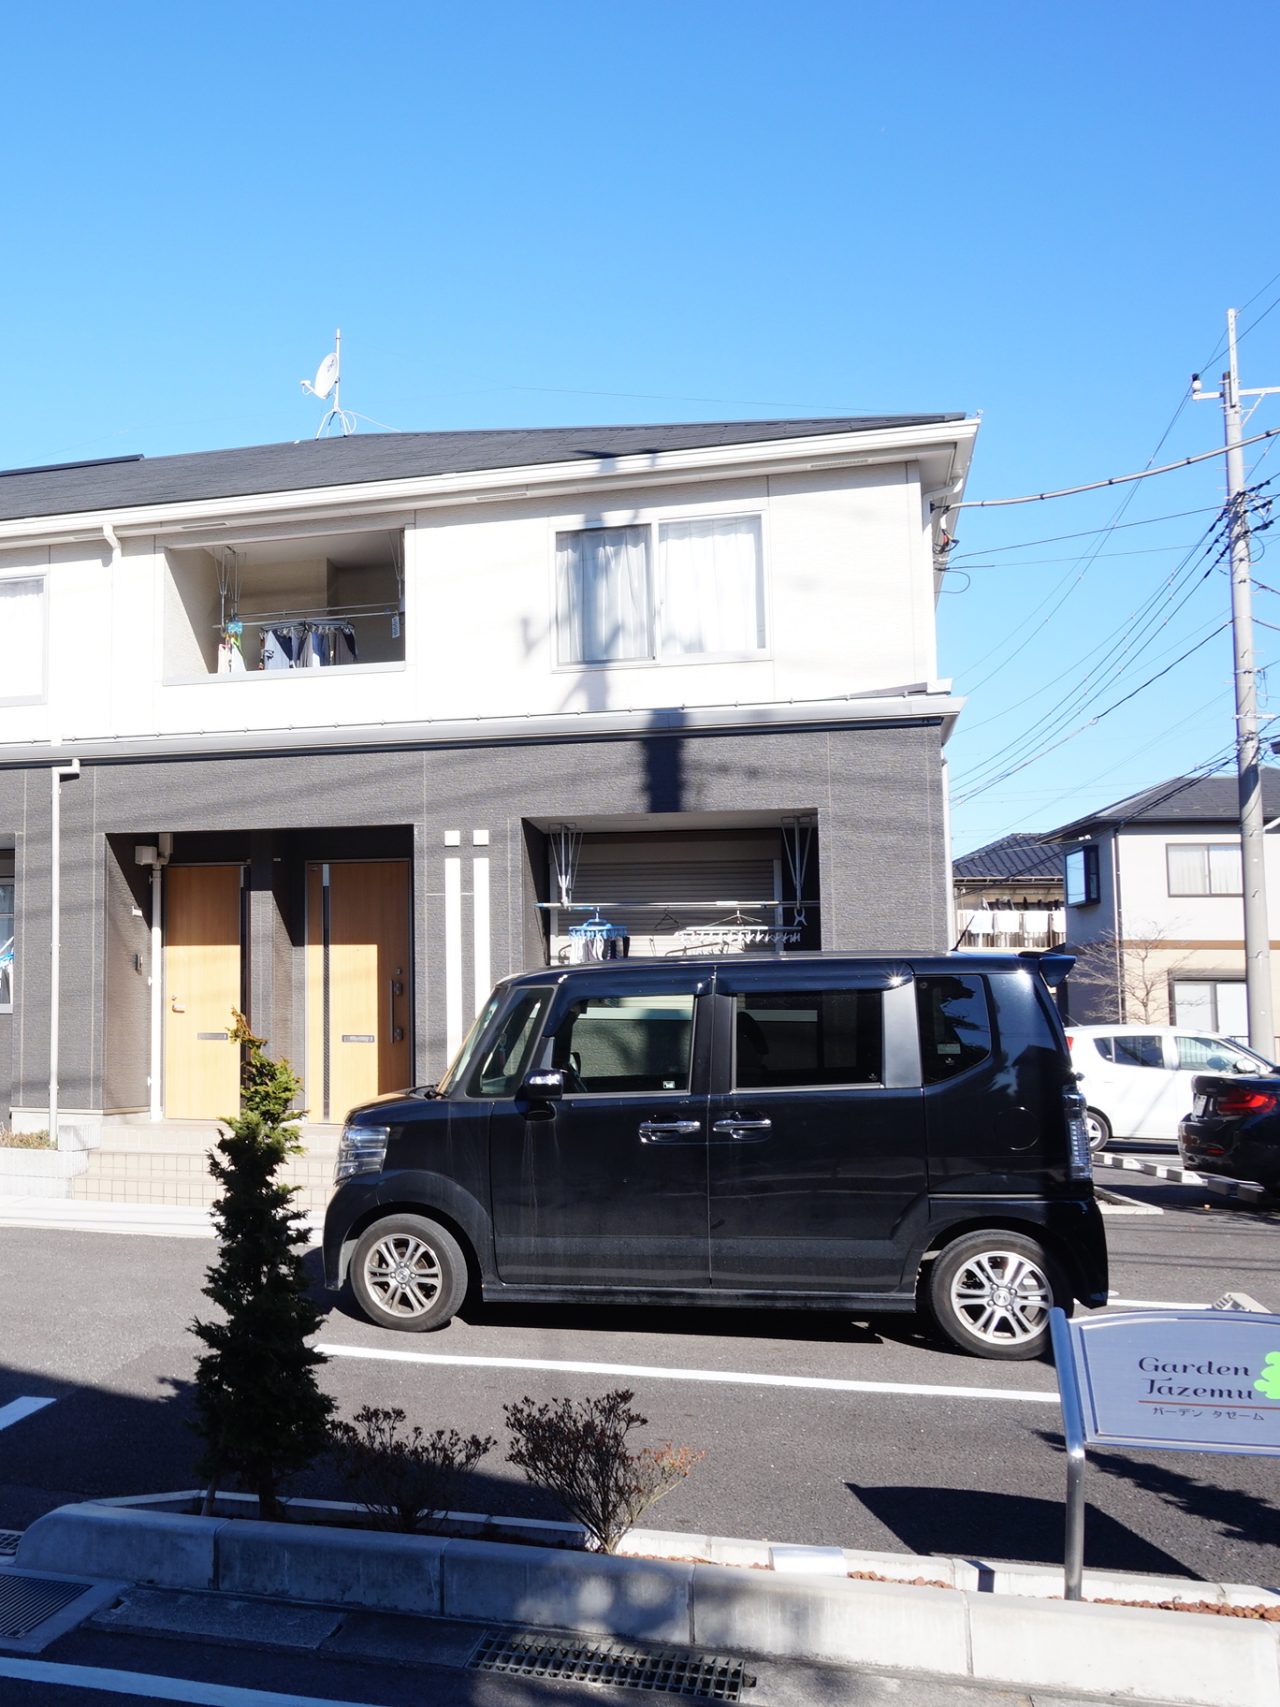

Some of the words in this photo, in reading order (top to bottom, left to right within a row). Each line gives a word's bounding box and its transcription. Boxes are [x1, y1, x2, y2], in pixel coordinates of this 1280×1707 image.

[1138, 1356, 1250, 1377] Garden
[1142, 1377, 1254, 1400] Tazemu
[1152, 1407, 1203, 1417] ガーデン
